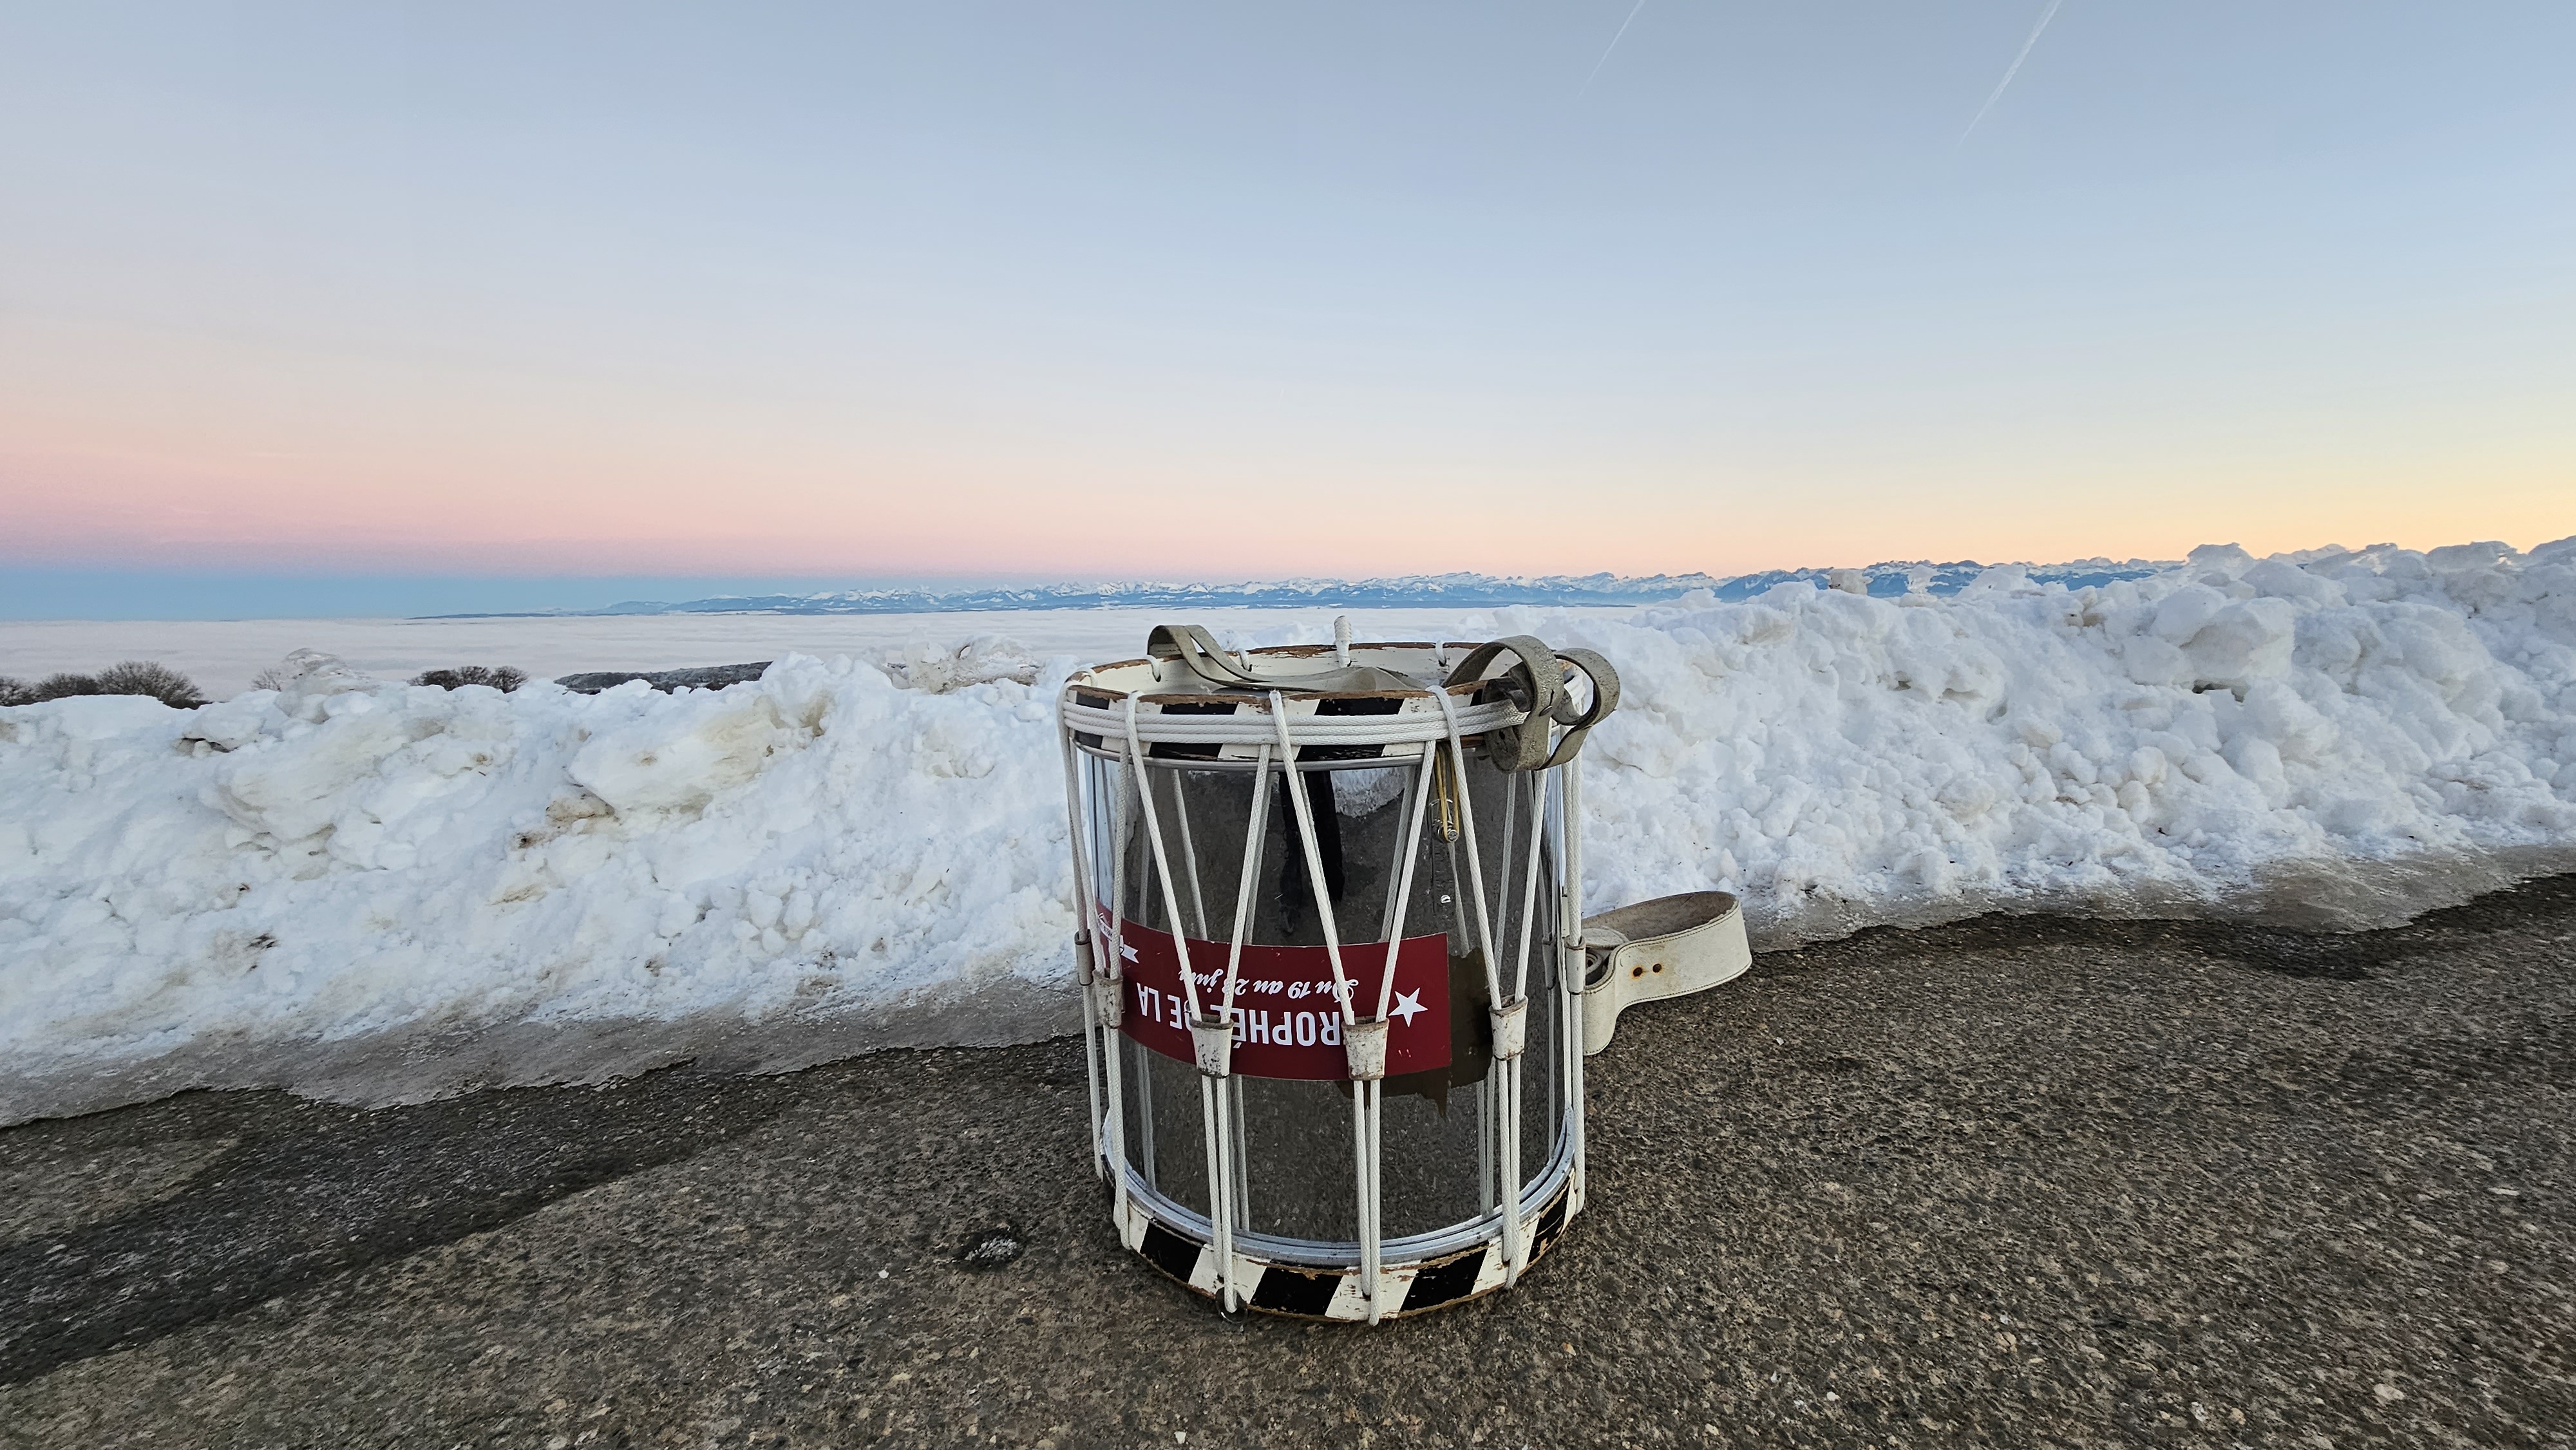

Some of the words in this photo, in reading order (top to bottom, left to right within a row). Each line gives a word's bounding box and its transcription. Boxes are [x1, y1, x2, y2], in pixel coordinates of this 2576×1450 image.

[1253, 979, 1284, 995] au
[1287, 981, 1311, 999] 19
[1314, 979, 1359, 1003] Du
[1136, 982, 1161, 1023] LA
[1210, 1004, 1355, 1050] ROPHÉ
